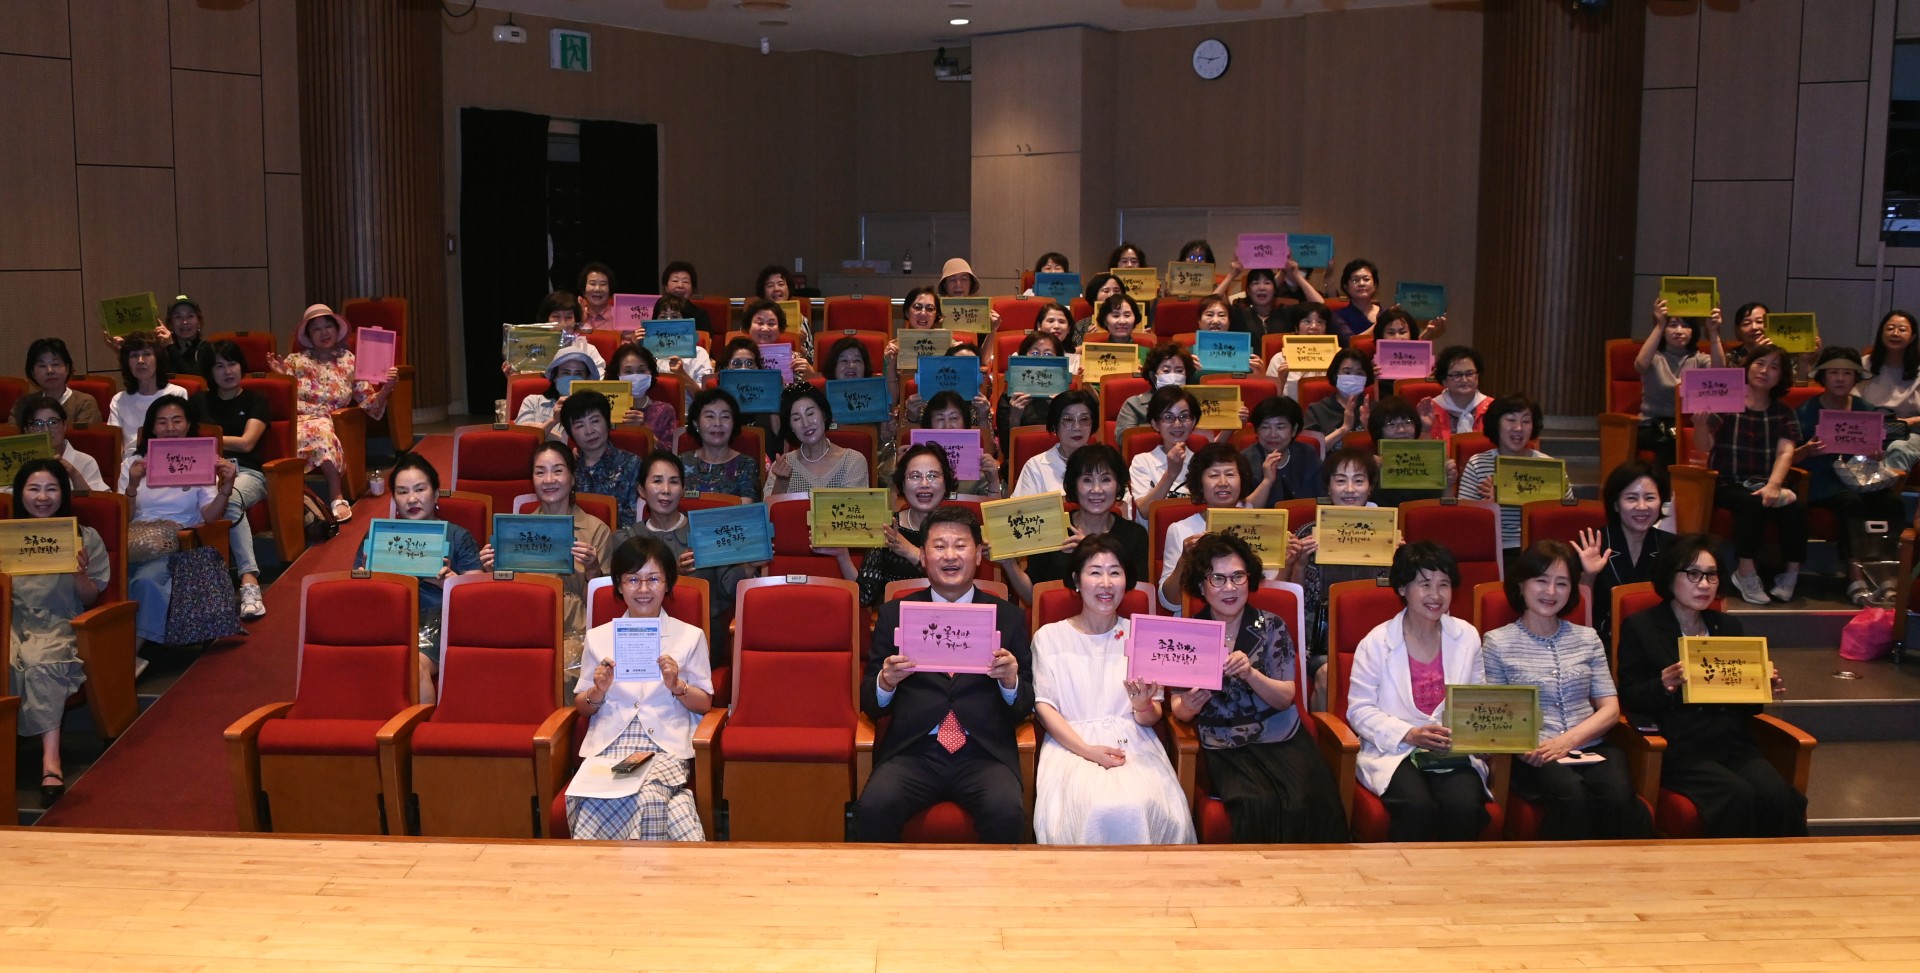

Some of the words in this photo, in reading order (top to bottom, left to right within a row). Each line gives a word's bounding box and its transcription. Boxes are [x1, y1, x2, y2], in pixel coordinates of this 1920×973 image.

[847, 504, 860, 513] 지금
[519, 531, 534, 543] 조금
[1024, 525, 1040, 538] 우리
[24, 535, 39, 546] 조금
[943, 626, 971, 642] 꽃길만
[1158, 639, 1174, 652] 조금
[1151, 652, 1170, 666] 느려도
[1172, 652, 1198, 665] 괜찮아
